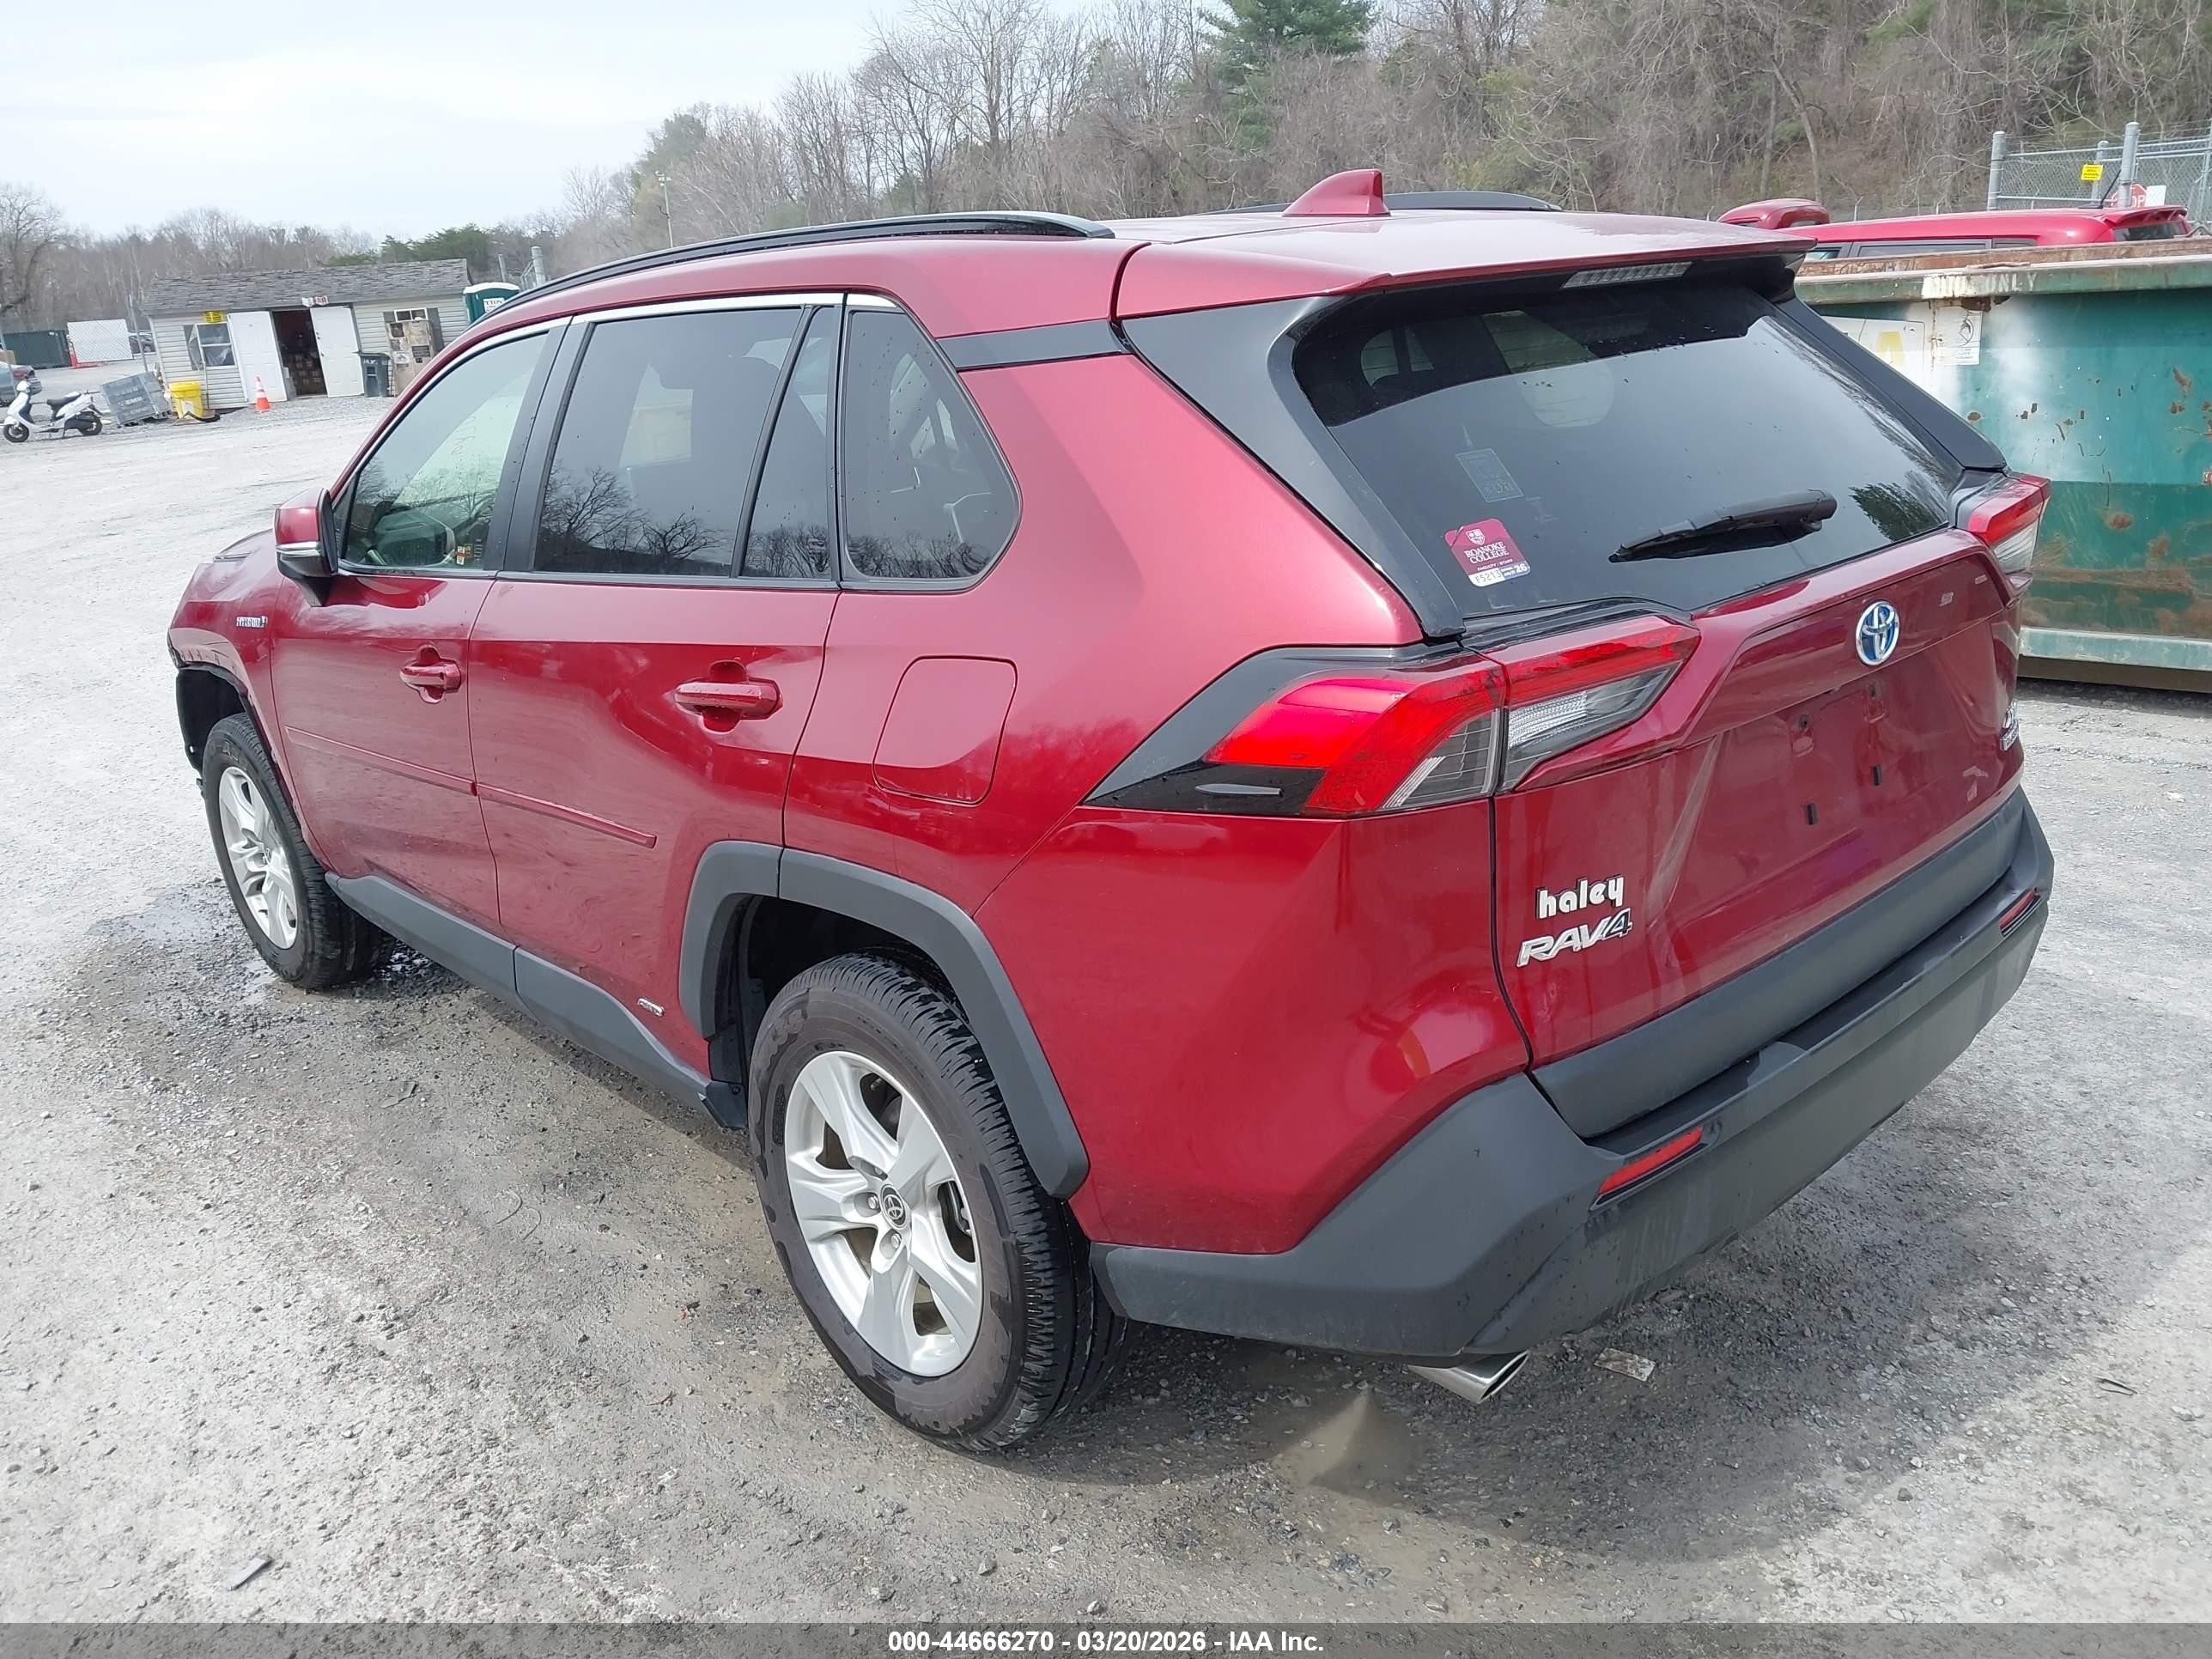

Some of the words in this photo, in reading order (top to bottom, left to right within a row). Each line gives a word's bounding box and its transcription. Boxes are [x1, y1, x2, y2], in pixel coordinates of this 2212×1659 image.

[1463, 541, 1506, 558] ROANOKE
[1469, 548, 1510, 564] COLLEGE
[1514, 563, 1528, 574] 26
[1537, 876, 1625, 920] haley
[1516, 908, 1632, 968] RAV4
